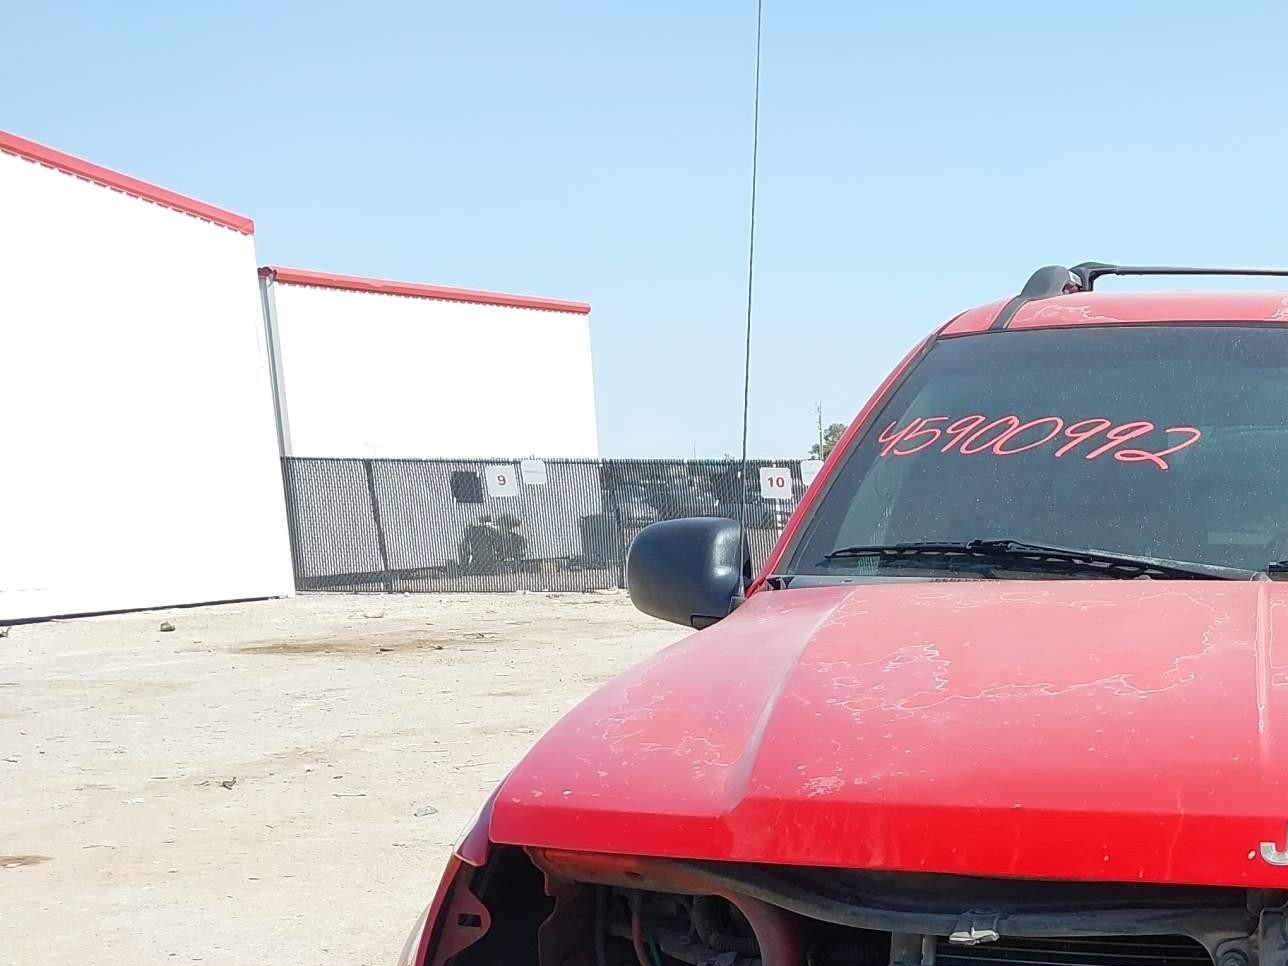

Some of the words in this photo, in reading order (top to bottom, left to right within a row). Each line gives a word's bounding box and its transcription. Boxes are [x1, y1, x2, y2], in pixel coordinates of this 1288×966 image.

[877, 414, 1202, 472] 45900992
[496, 474, 507, 486] 9
[767, 476, 786, 488] 10
